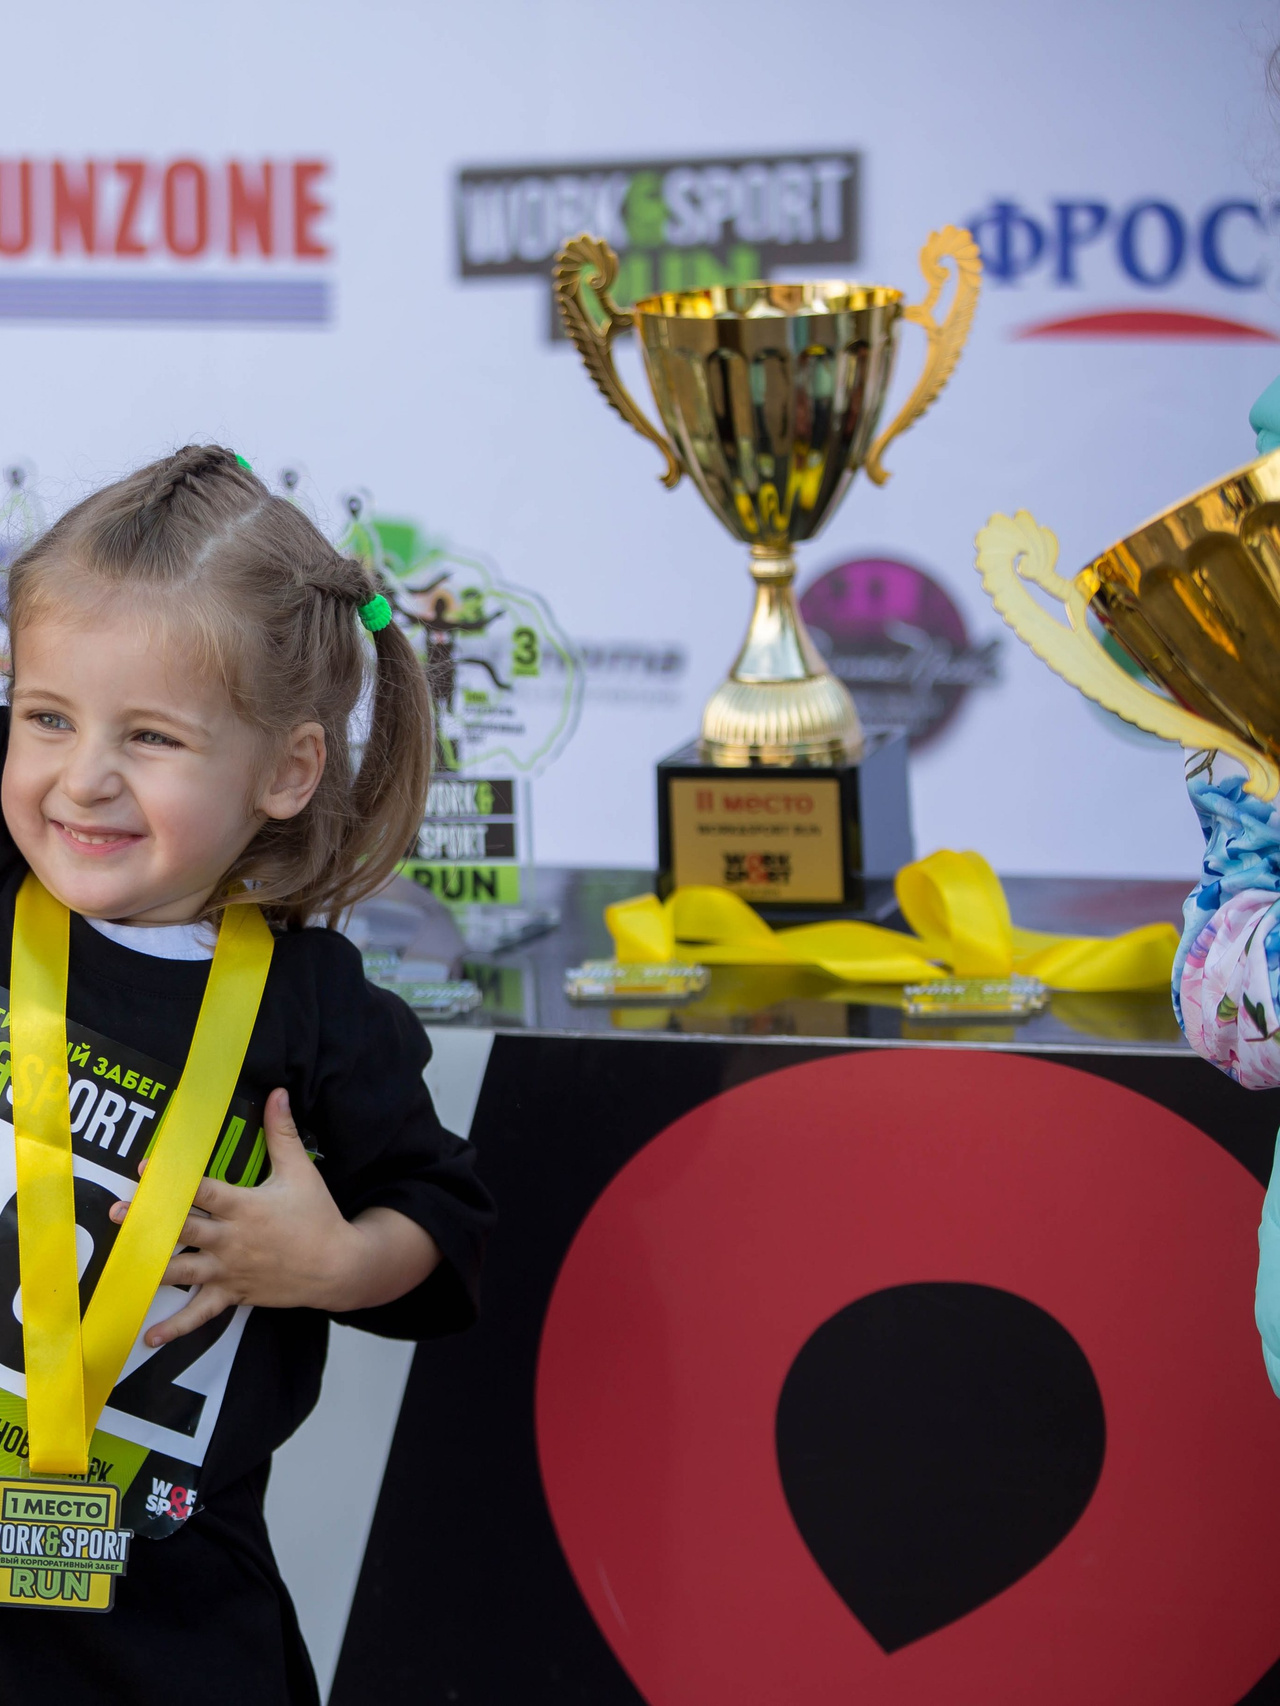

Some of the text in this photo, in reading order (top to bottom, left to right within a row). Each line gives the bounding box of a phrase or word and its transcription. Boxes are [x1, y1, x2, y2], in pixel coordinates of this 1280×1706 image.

[966, 197, 1280, 292] ФРОС
[514, 628, 537, 666] 3
[92, 1056, 167, 1101] ЗАБЕГ
[11, 1498, 102, 1518] 1 МЕСТО
[20, 1557, 94, 1570] КОРПОРАТИВНЫЙ
[94, 1562, 120, 1571] ЗАБЕГ
[10, 1568, 90, 1601] RUN
